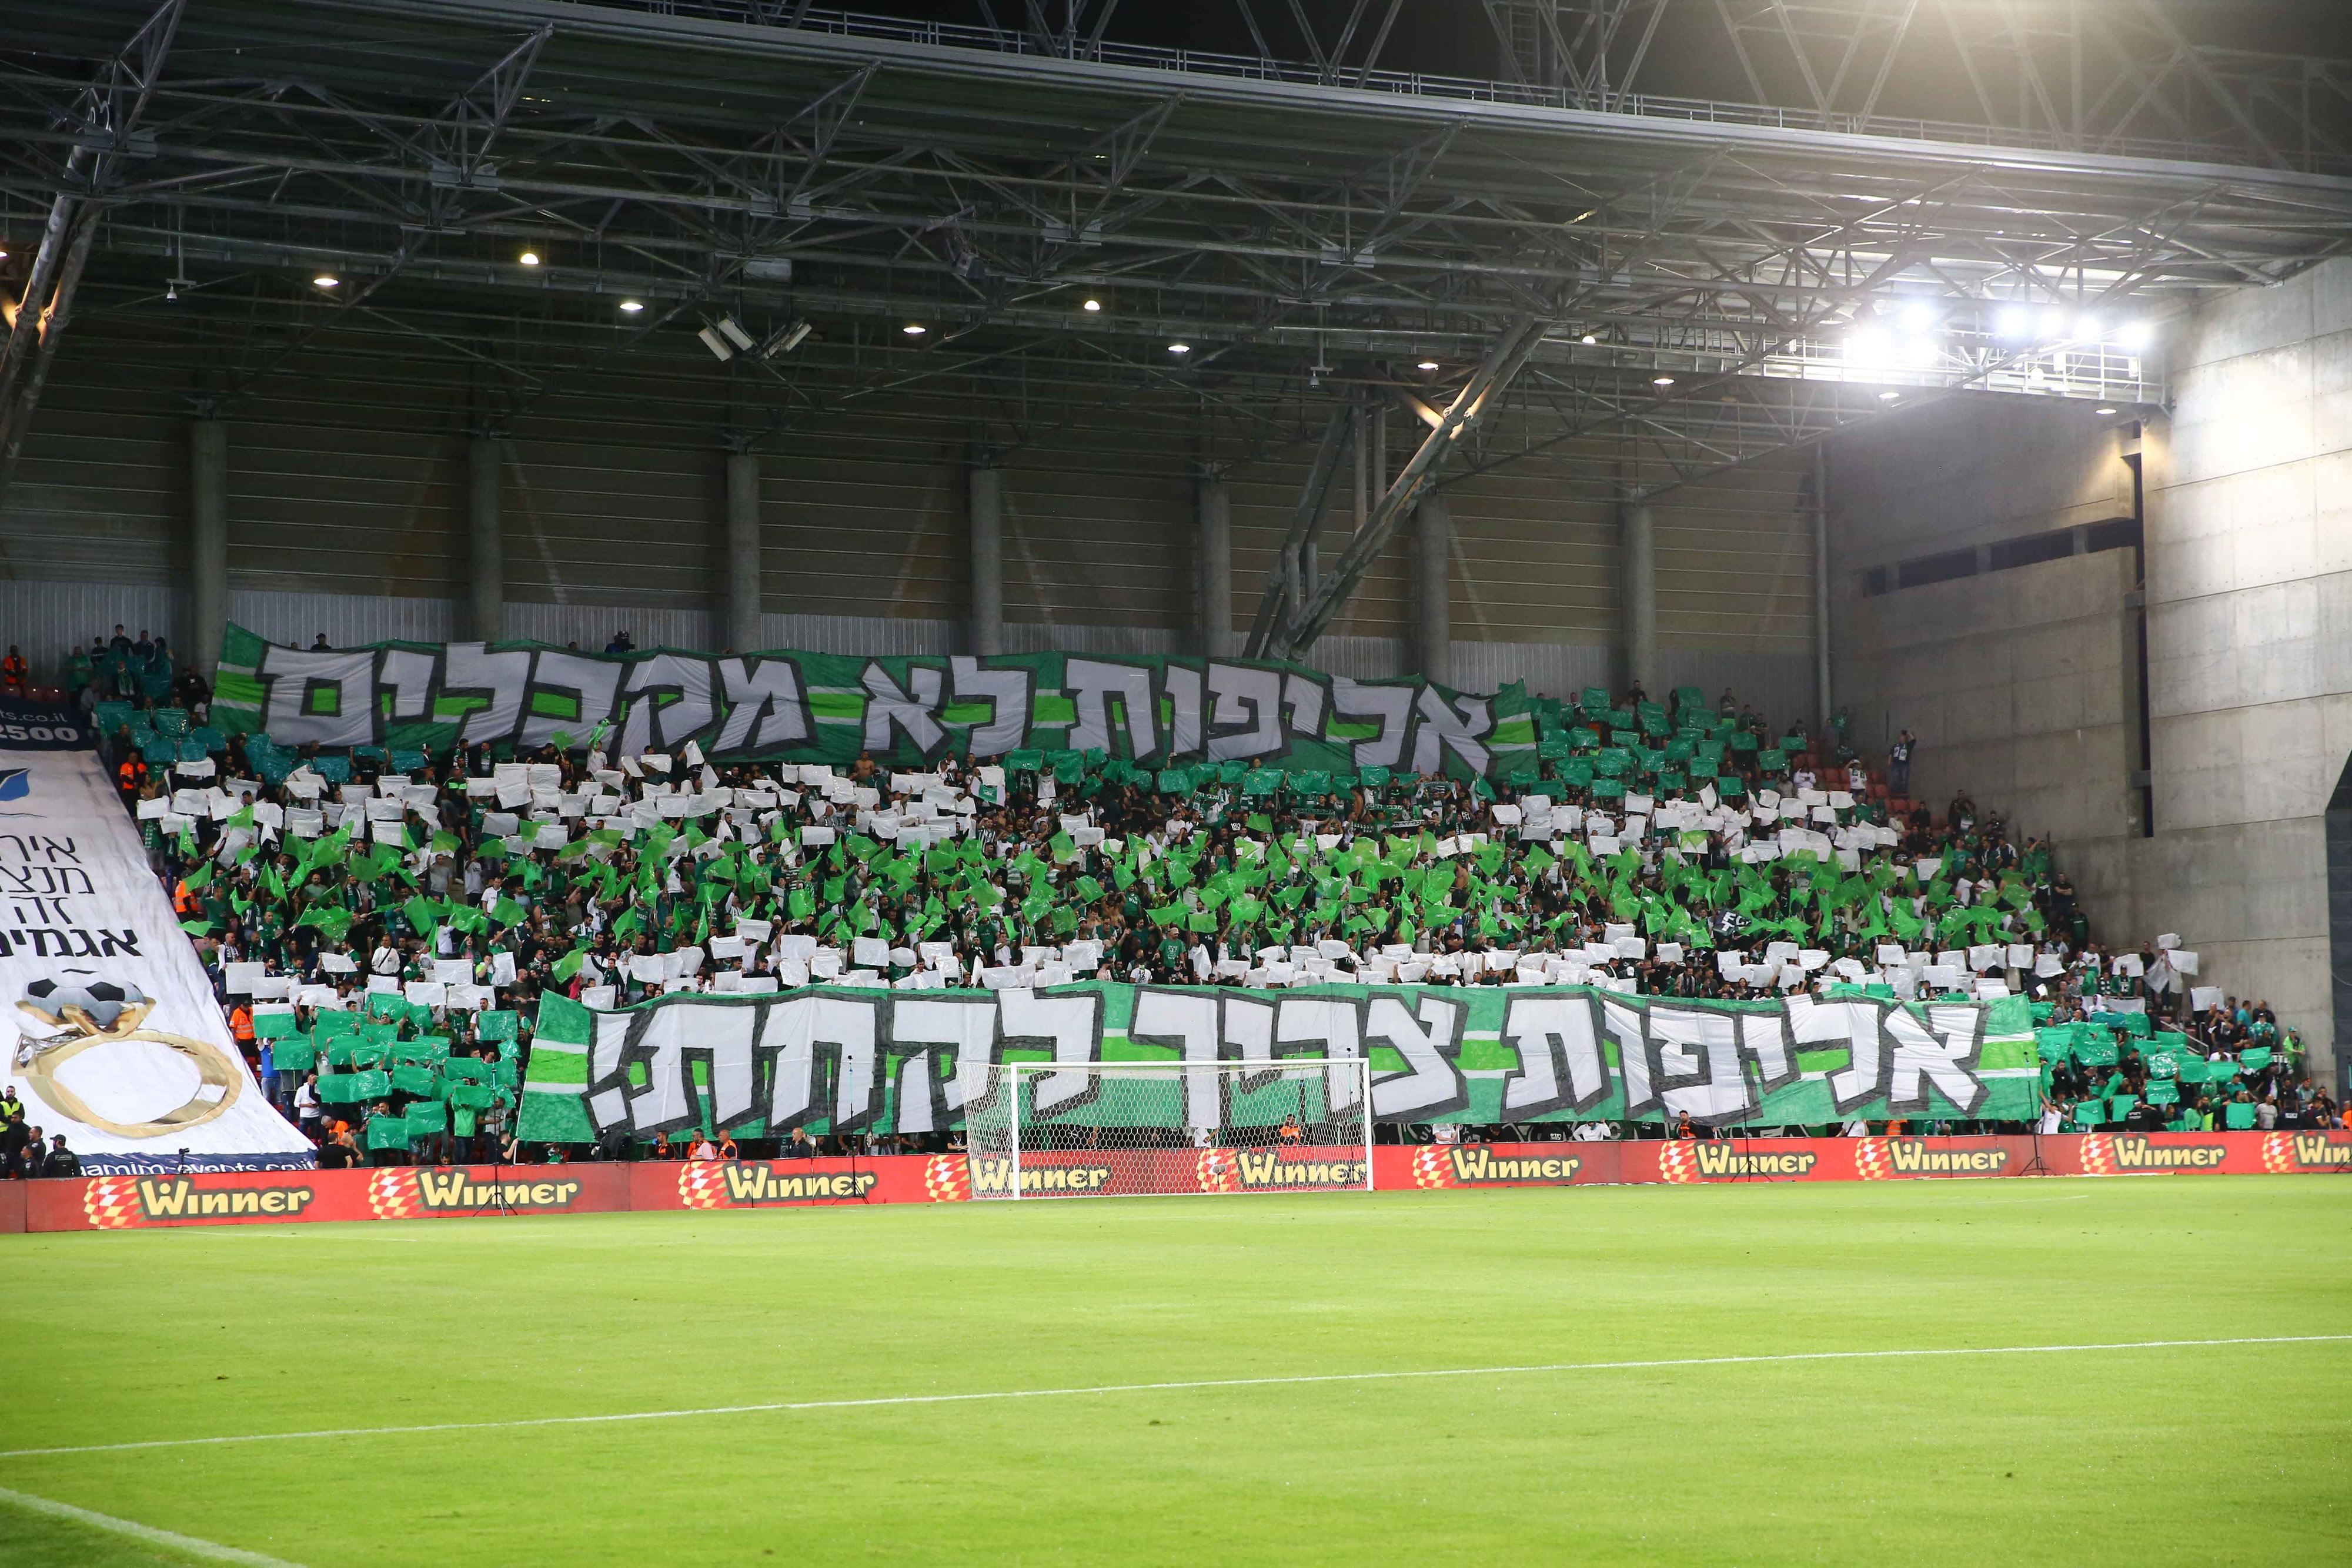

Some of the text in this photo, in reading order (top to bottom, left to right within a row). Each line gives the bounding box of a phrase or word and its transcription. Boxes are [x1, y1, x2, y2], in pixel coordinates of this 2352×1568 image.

[258, 640, 1499, 779] אליפות לא מקבלים
[0, 866, 95, 894] מנצ
[9, 897, 73, 924] זה
[582, 987, 1991, 1135] אליפות צריך לקחת!
[1452, 1148, 1579, 1178] Winner
[1697, 1144, 1815, 1174] Winner
[1890, 1141, 2006, 1171] Winner
[2114, 1137, 2224, 1166] Winner
[729, 1166, 874, 1199] Winner
[971, 1158, 1108, 1191] Winner
[1239, 1152, 1366, 1183] Winner
[141, 1179, 310, 1216] Winner
[421, 1171, 577, 1206] Winner
